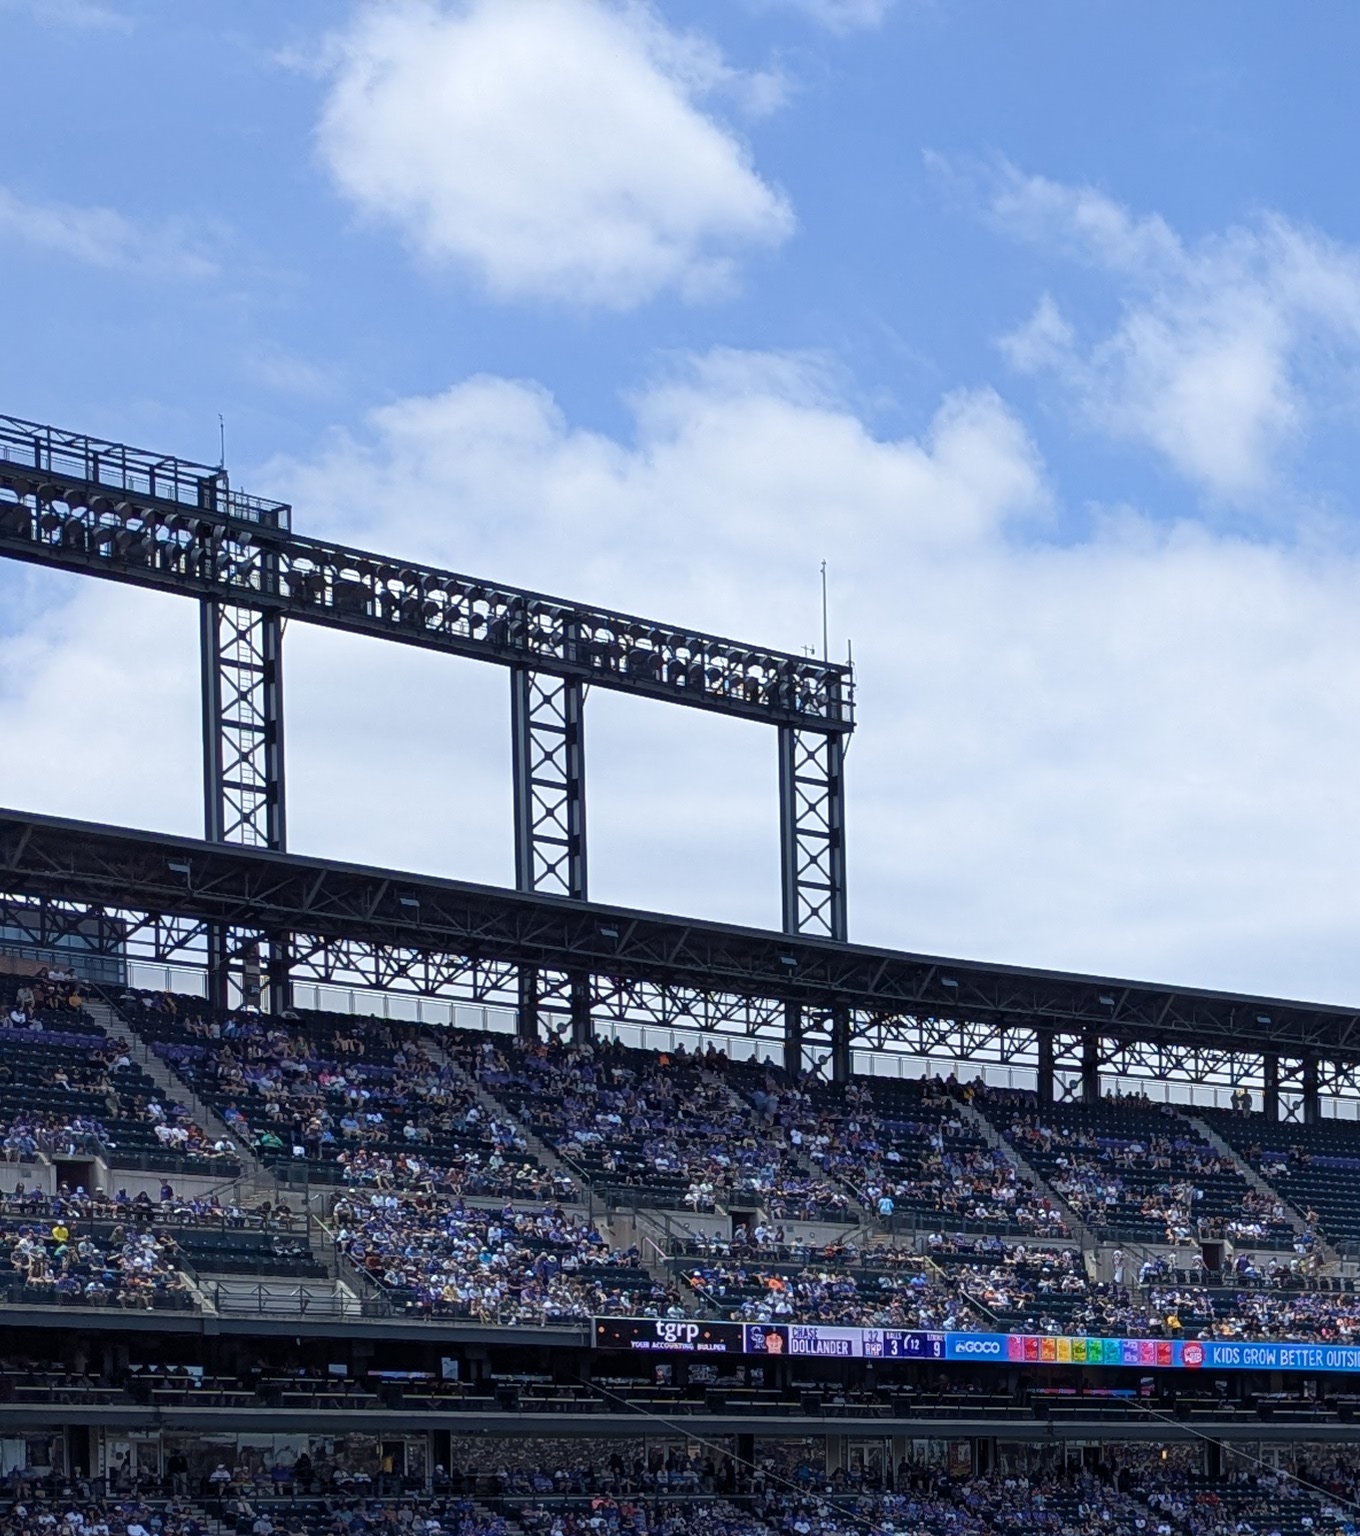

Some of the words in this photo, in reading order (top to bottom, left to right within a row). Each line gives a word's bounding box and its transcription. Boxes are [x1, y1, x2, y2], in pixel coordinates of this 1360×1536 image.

[655, 1320, 699, 1343] tgrp
[791, 1327, 818, 1339] CHASE
[791, 1339, 849, 1355] DOLLANDER
[965, 1341, 1000, 1354] GOCO
[1213, 1347, 1240, 1364] KIDS
[1243, 1348, 1276, 1365] GROW
[1280, 1349, 1324, 1367] BETTER
